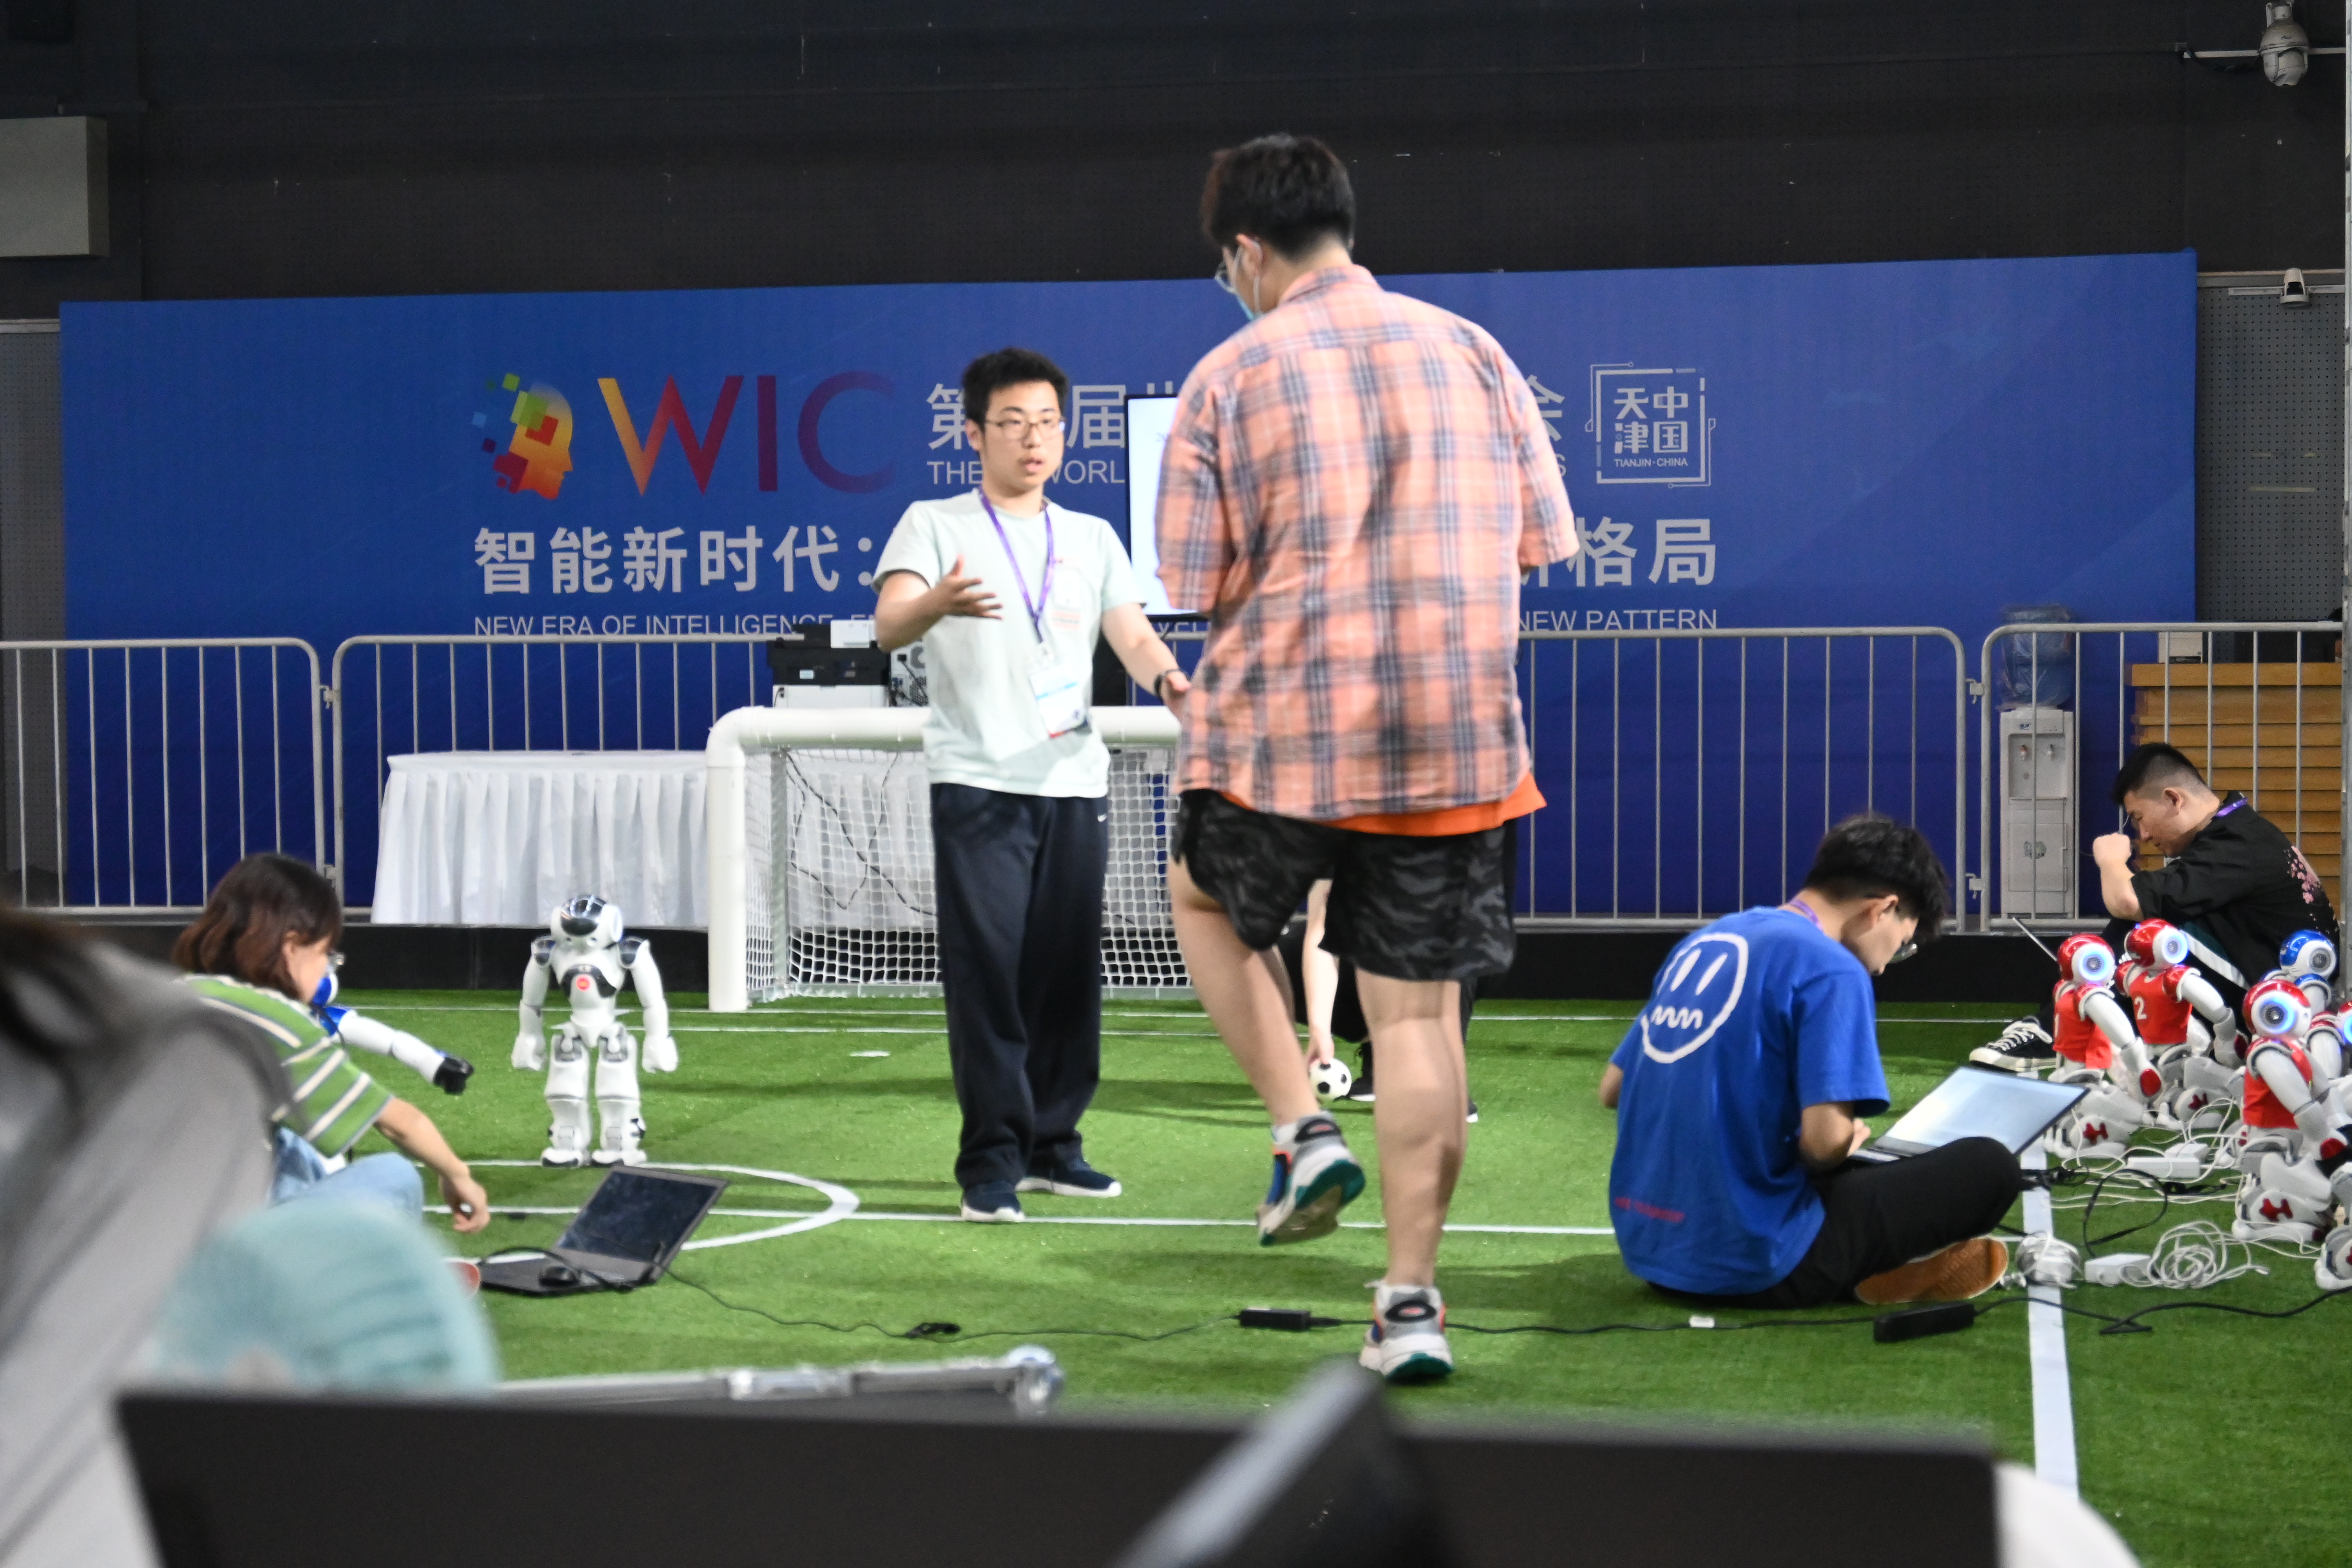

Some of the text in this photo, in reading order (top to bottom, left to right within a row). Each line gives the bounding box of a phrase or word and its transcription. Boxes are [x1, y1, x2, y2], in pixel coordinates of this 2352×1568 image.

[597, 370, 896, 496] WIC
[927, 460, 1126, 485] THE ORL
[475, 616, 534, 635] NEW
[542, 615, 593, 635] ERA
[602, 615, 636, 635] OF
[1519, 610, 1717, 631] NEW PATTERN
[2134, 996, 2147, 1020] 2
